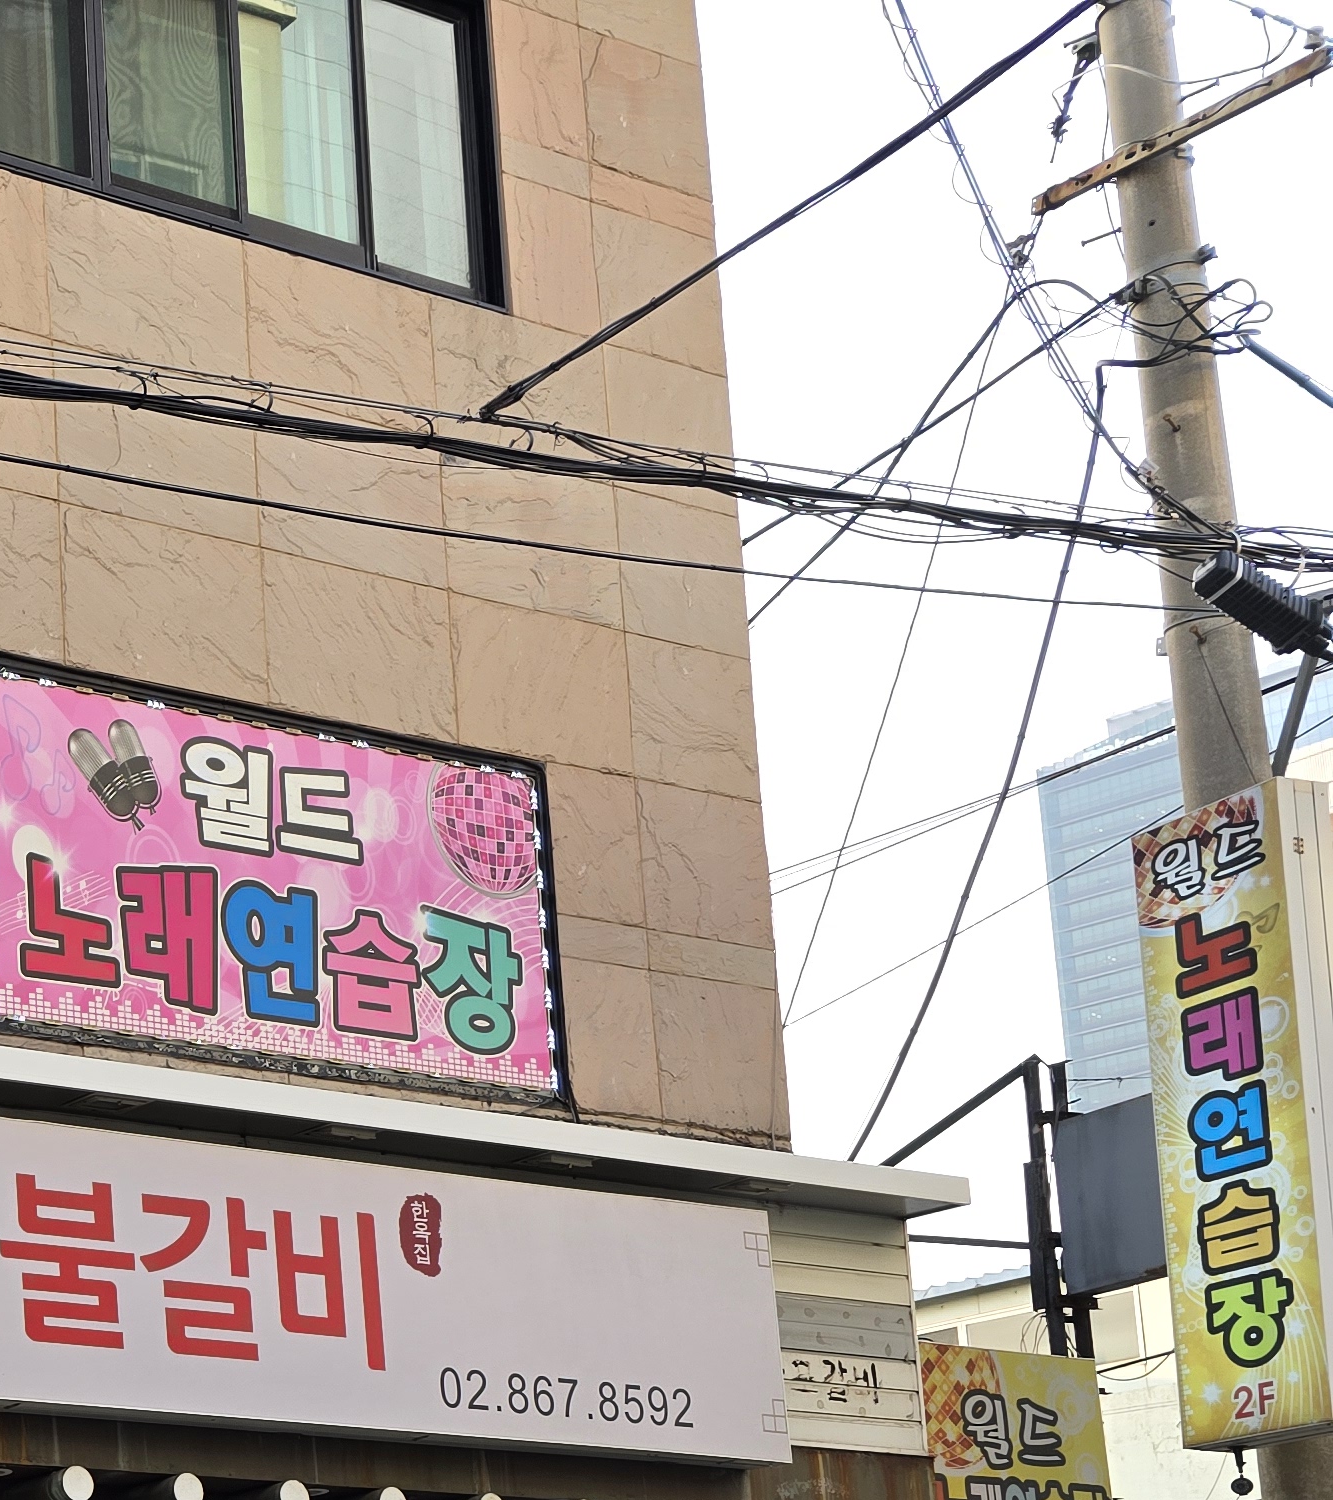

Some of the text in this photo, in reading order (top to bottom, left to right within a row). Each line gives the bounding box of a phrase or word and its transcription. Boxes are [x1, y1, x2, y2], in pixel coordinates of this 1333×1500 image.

[180, 735, 363, 866] 월드
[1152, 818, 1266, 900] 월드
[20, 851, 522, 1055] 노래연습장
[1176, 914, 1294, 1367] 노래연습장
[410, 1200, 432, 1265] 한옥집
[439, 1366, 695, 1429] 02.867.8592
[961, 1389, 1066, 1470] 월드
[1232, 1378, 1278, 1423] 2F
